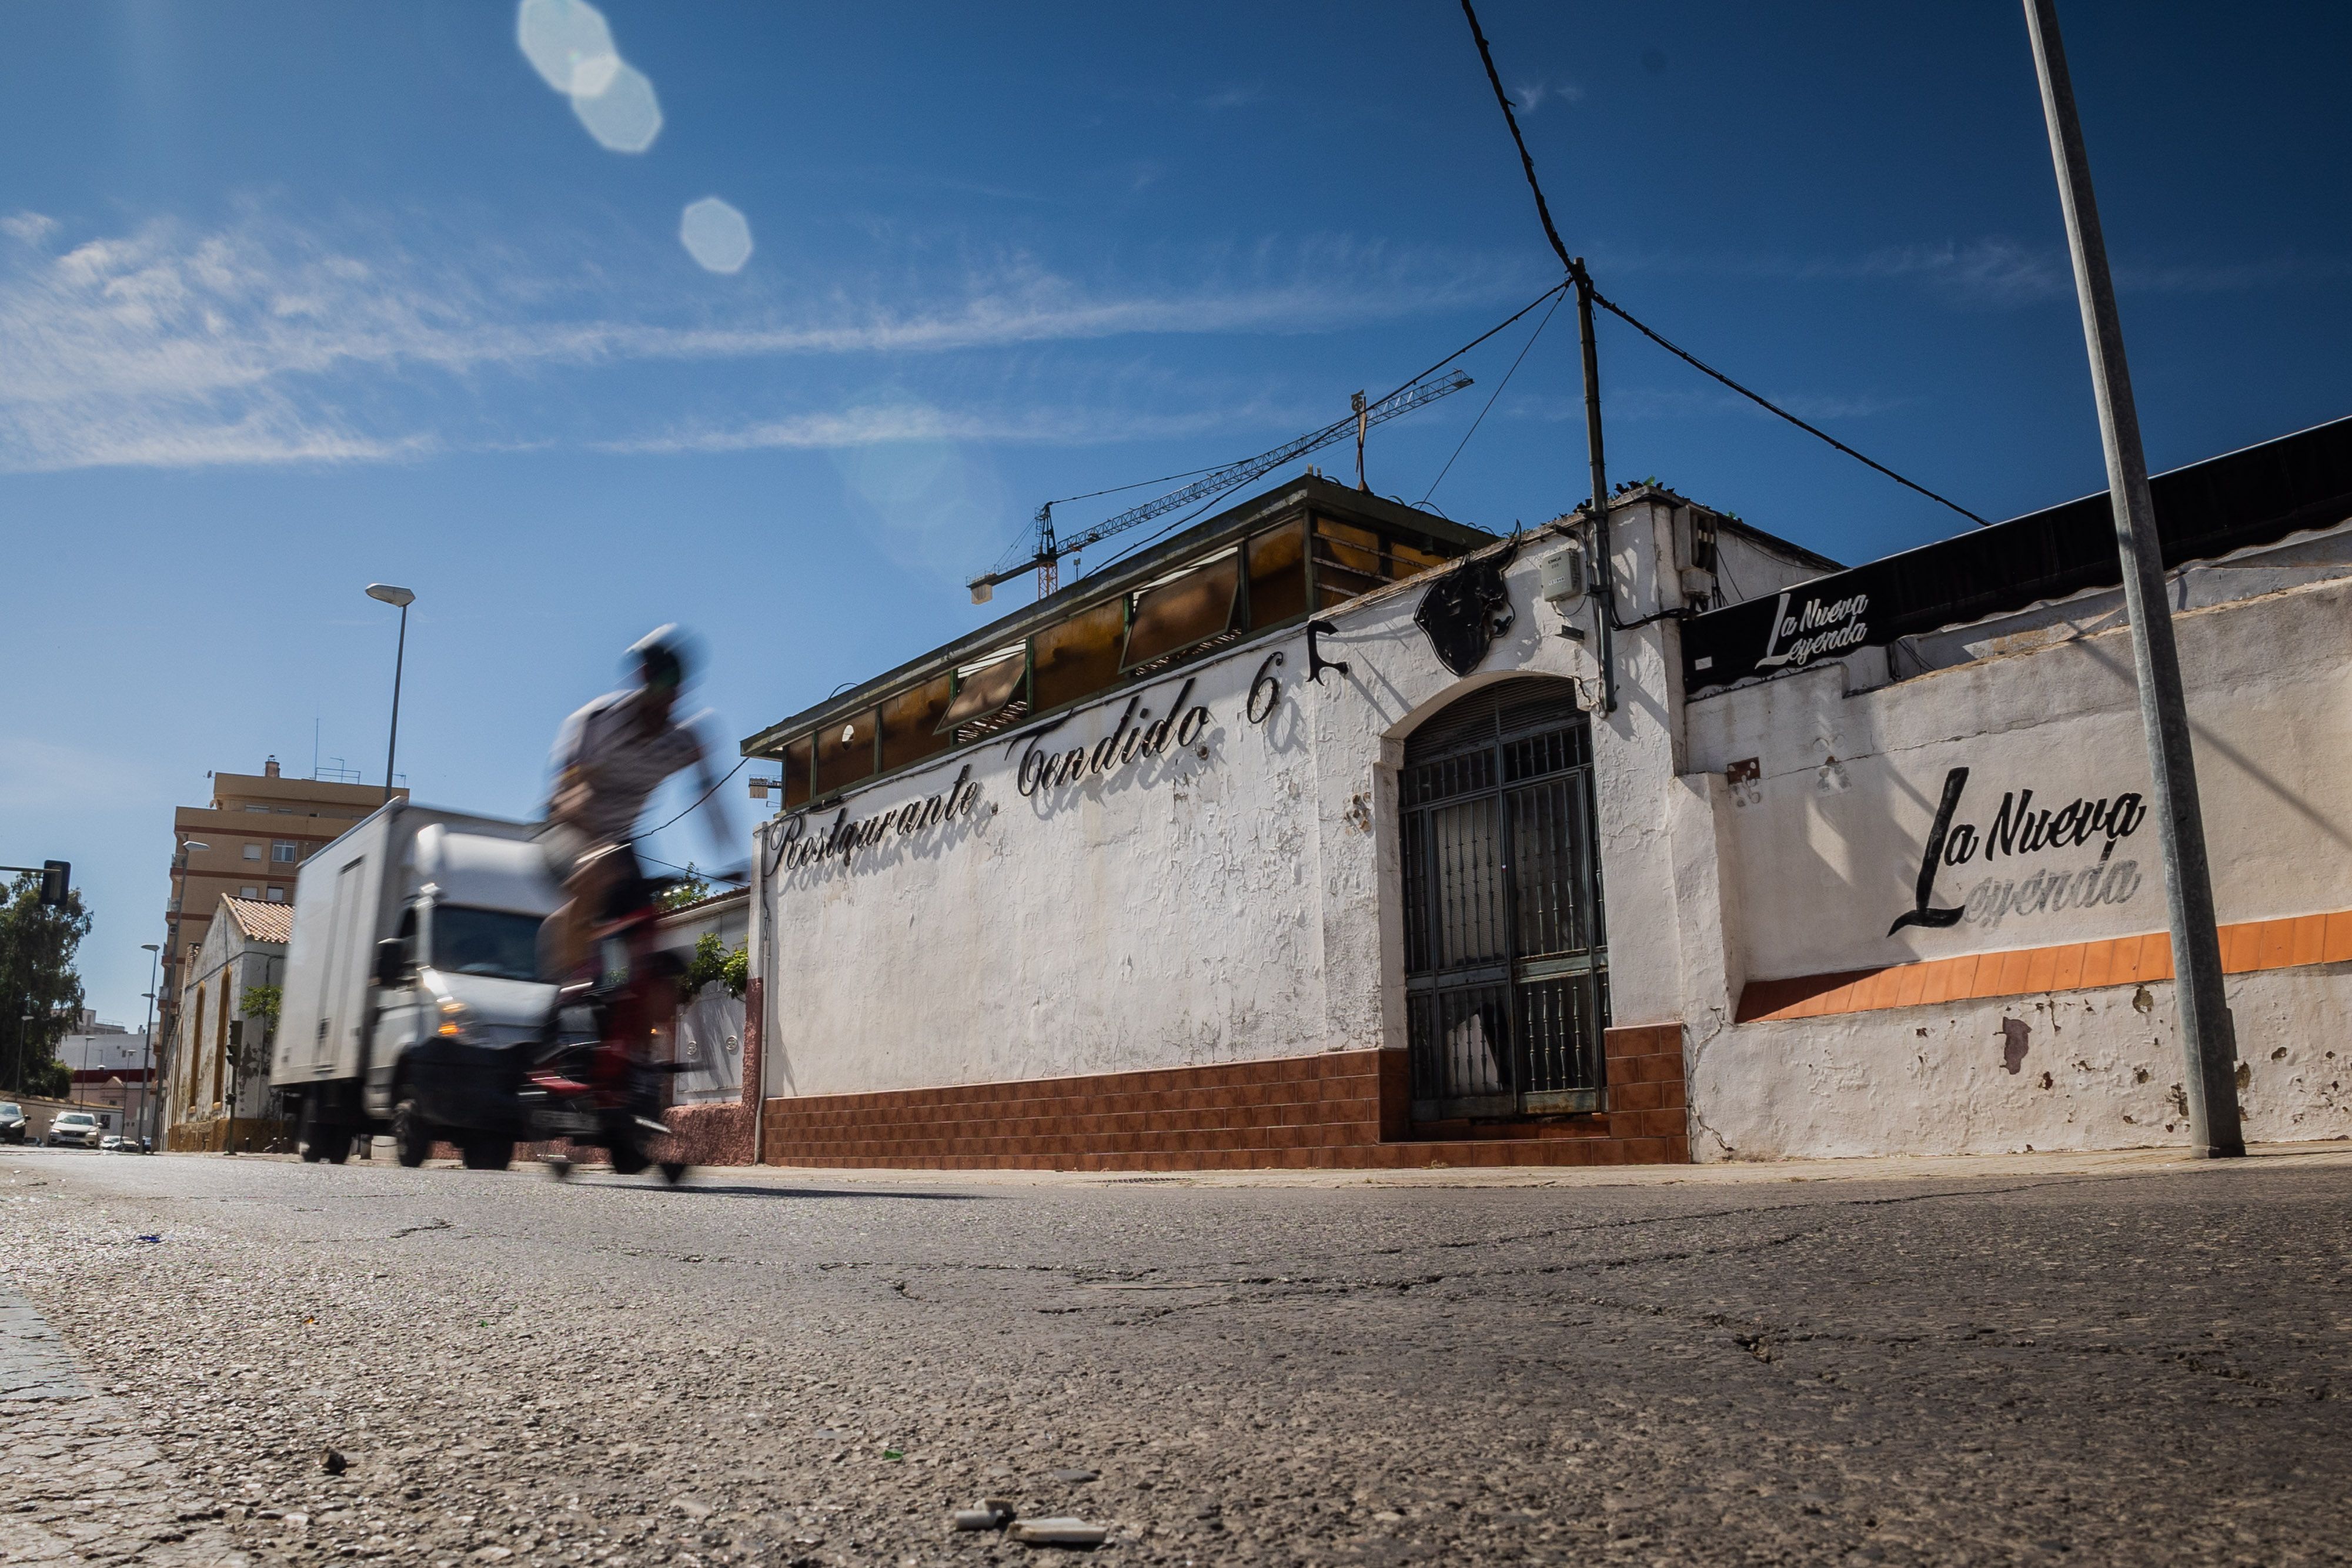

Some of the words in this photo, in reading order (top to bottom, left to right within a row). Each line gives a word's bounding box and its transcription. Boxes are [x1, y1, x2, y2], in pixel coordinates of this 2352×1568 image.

[1799, 594, 1868, 632] Nueva
[763, 764, 978, 877] Restaurante
[1004, 677, 1209, 797] Tendido
[1246, 651, 1284, 724] 6
[1985, 788, 2147, 861] Nueva
